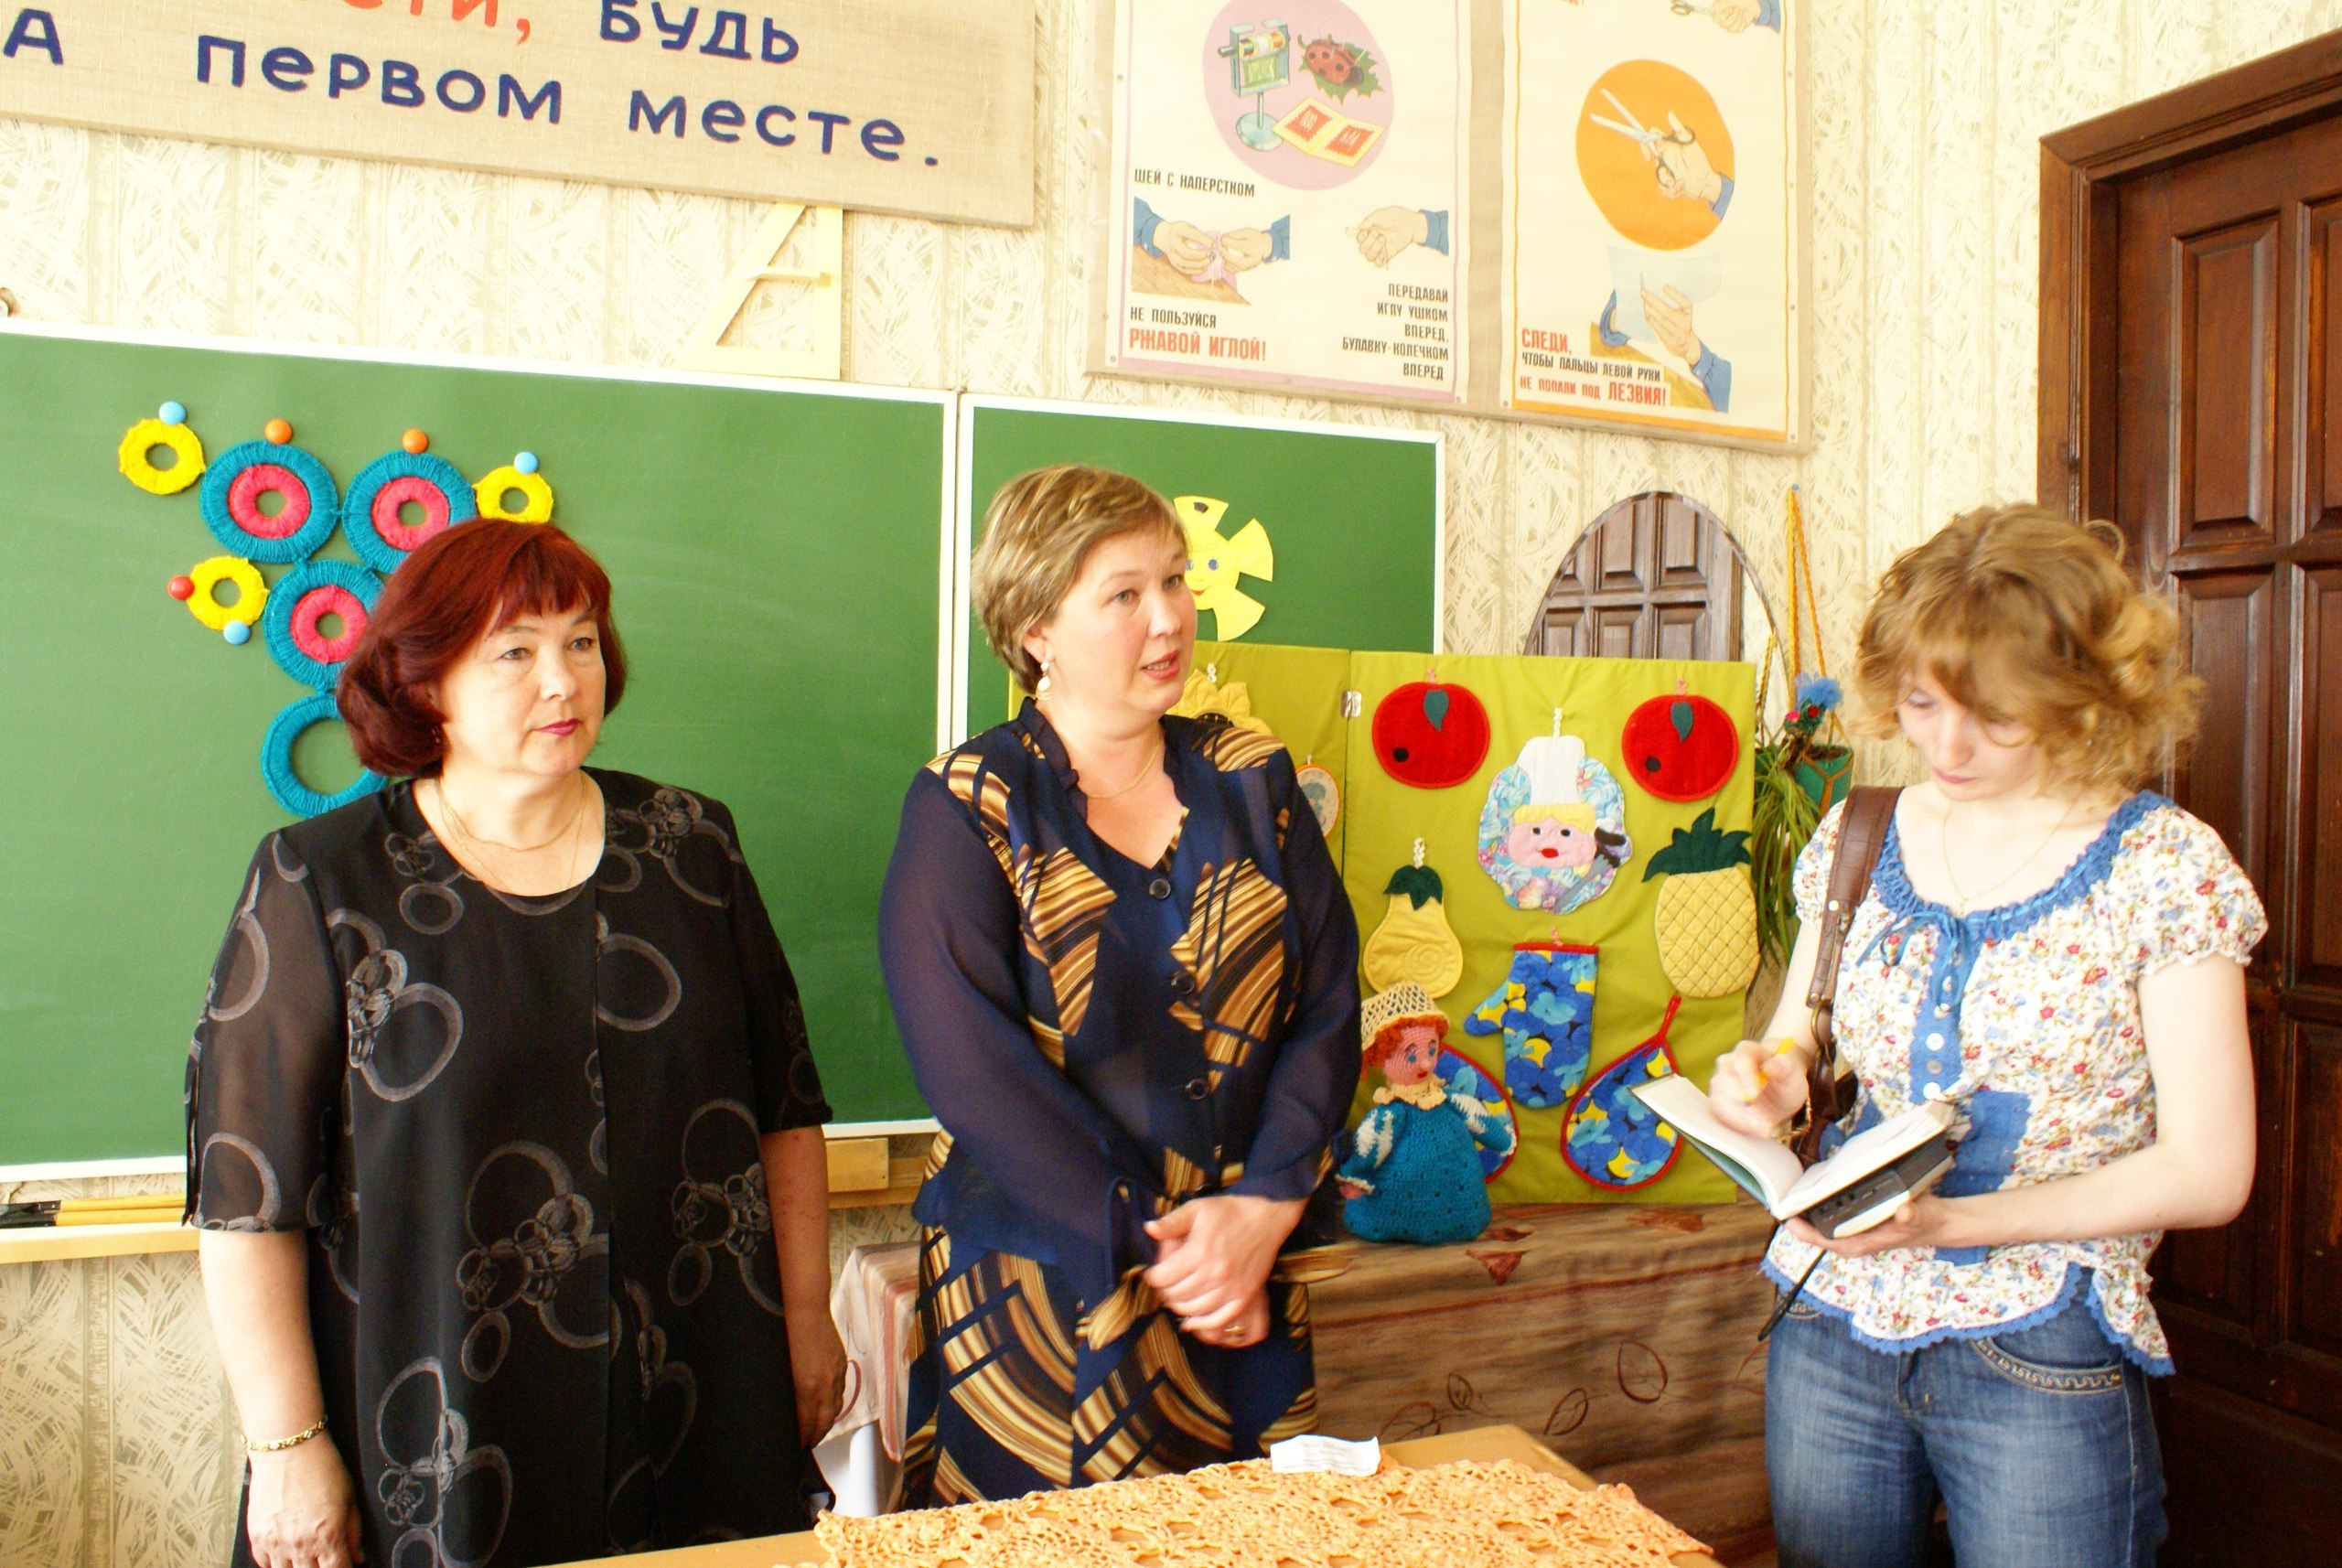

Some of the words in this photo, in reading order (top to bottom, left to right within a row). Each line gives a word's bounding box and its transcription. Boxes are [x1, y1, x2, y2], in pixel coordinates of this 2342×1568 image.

[1133, 168, 1162, 185] ШЕЙ
[1167, 172, 1175, 188] С
[1180, 173, 1255, 198] НАПЕРСТКОМ
[1388, 283, 1448, 303] ПЕРЕДАВАЙ
[1130, 306, 1144, 321] НЕ
[1151, 308, 1217, 328] ПОЛЬЗУЙСЯ
[1377, 302, 1402, 317] ИГЛУ
[1409, 306, 1448, 322] УШКОМ
[1129, 328, 1200, 355] РЖАВОЙ
[1209, 335, 1267, 361] ИГЛОЙ!
[1521, 328, 1573, 355] СЛЕДИ,
[1402, 362, 1444, 381] ВПЕРЕД
[1521, 351, 1553, 368] ЧТОБЫ
[1559, 356, 1598, 375] ПАЛЬЦЫ
[1603, 363, 1633, 379] ЛЕВОЙ
[1638, 367, 1660, 382] РУКИ
[1520, 376, 1532, 390] НЕ
[1538, 378, 1576, 395] ПОПАЛИ
[1581, 383, 1601, 400] ПОД
[1608, 381, 1667, 407] ЛЕЗВИЯ!
